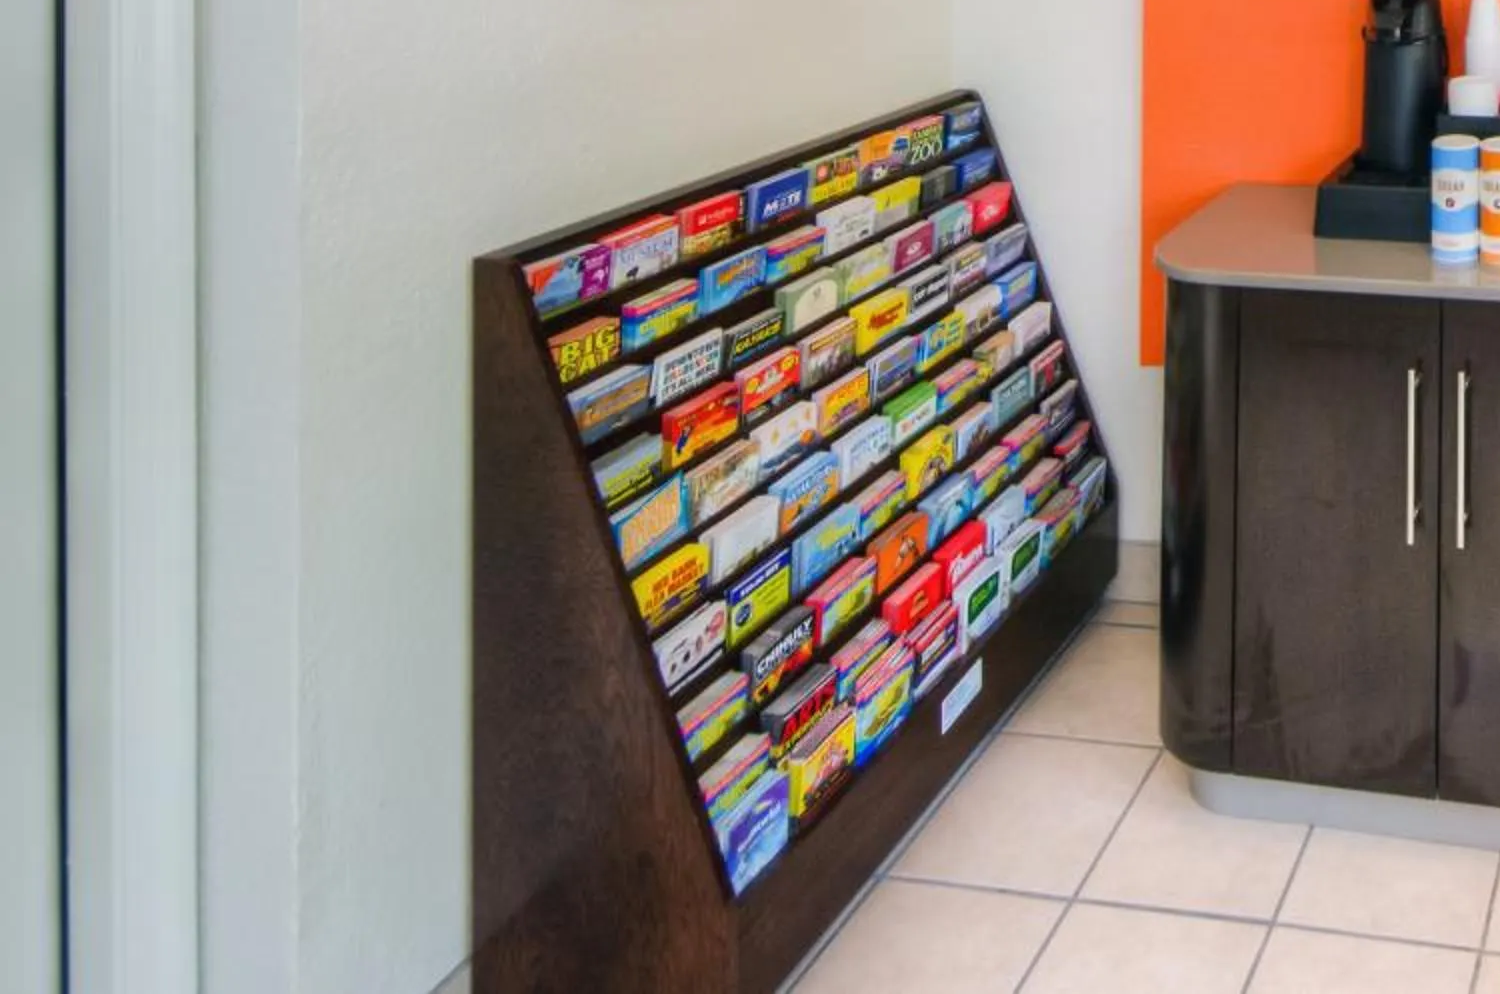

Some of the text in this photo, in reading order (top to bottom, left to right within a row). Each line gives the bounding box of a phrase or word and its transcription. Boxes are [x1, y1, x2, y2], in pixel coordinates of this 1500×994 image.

[910, 138, 943, 165] ZOO
[560, 325, 616, 365] BIG
[560, 346, 610, 384] CAT
